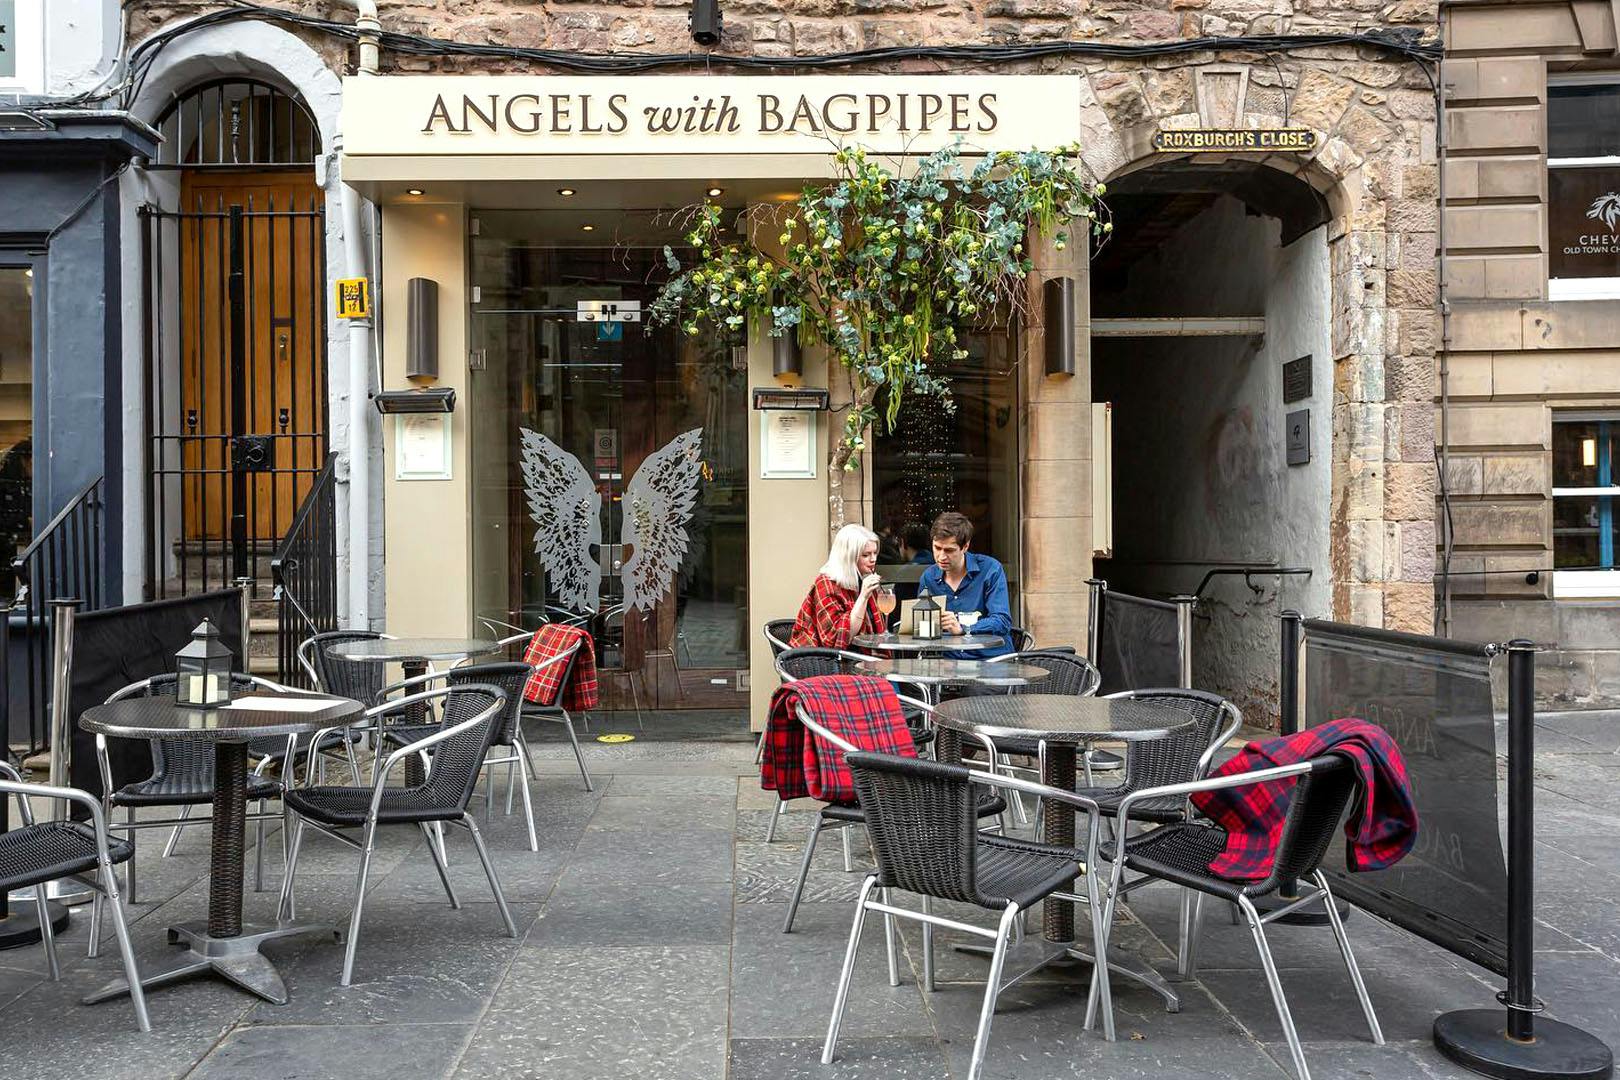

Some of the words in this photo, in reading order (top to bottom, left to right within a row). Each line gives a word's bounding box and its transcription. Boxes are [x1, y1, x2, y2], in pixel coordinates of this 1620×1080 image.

[421, 94, 629, 133] ANGELS
[643, 95, 741, 133] with
[757, 93, 998, 133] BAGPIPES
[1164, 132, 1254, 146] ROXBURGH'S
[1261, 132, 1307, 145] CLOSE
[1563, 246, 1581, 255] OLD
[1582, 246, 1609, 254] TOWN
